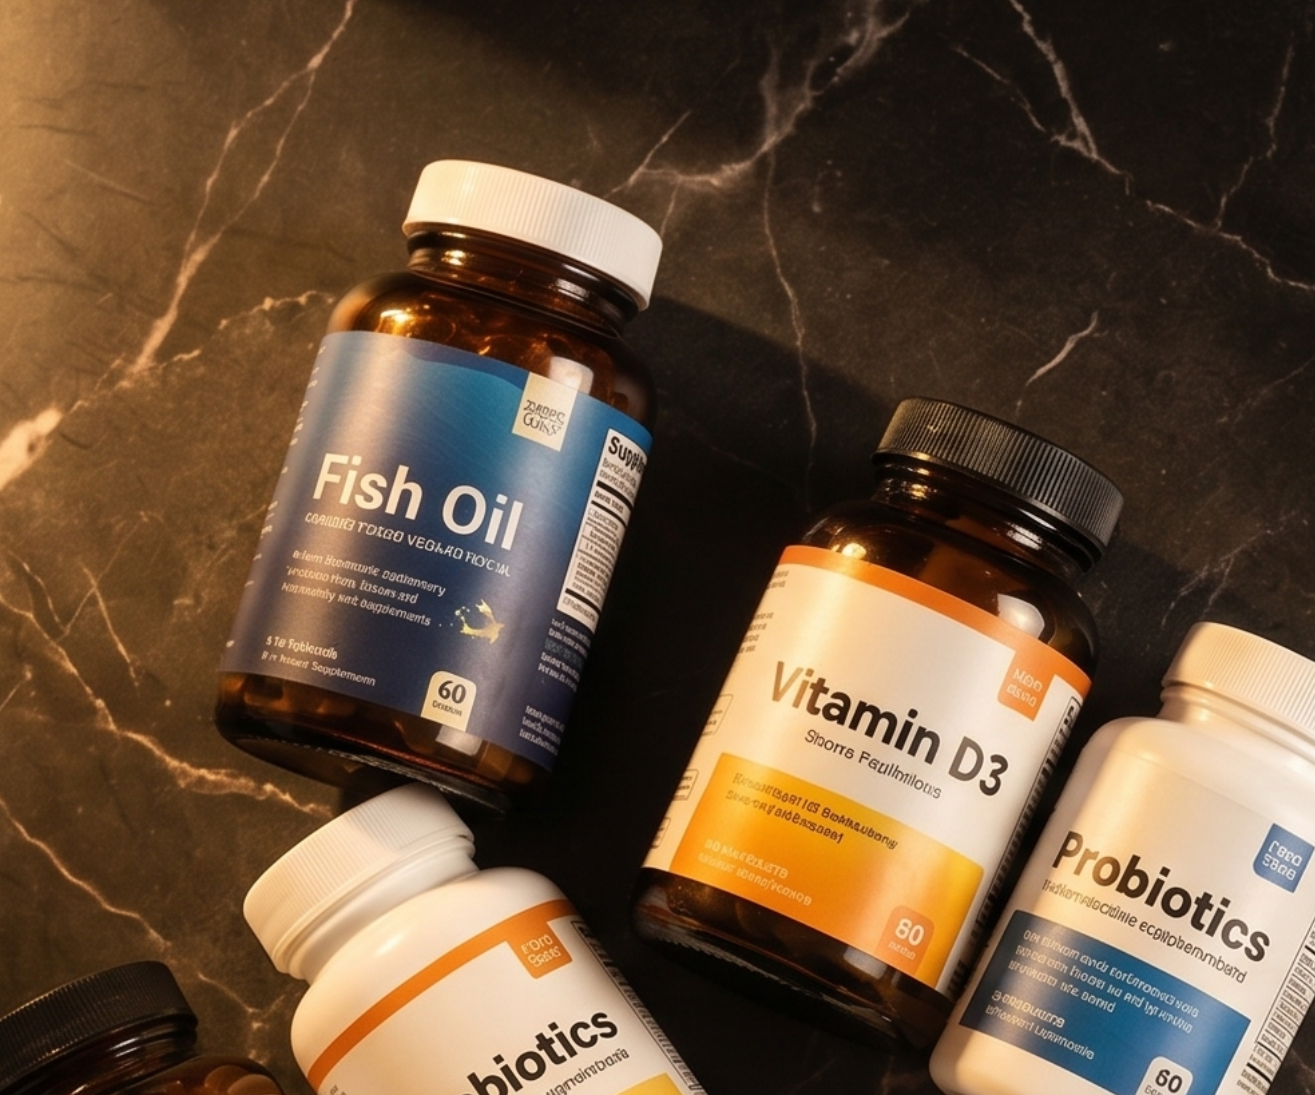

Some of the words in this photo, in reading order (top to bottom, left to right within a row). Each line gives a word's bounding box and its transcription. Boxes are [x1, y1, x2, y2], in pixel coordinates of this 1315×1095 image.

[312, 453, 423, 521] Fish
[441, 484, 524, 551] Oil
[437, 679, 467, 705] 60
[772, 661, 941, 765] Vitamin
[947, 735, 1009, 797] D3
[1051, 829, 1270, 962] Probiotics
[1154, 1068, 1183, 1094] 60
